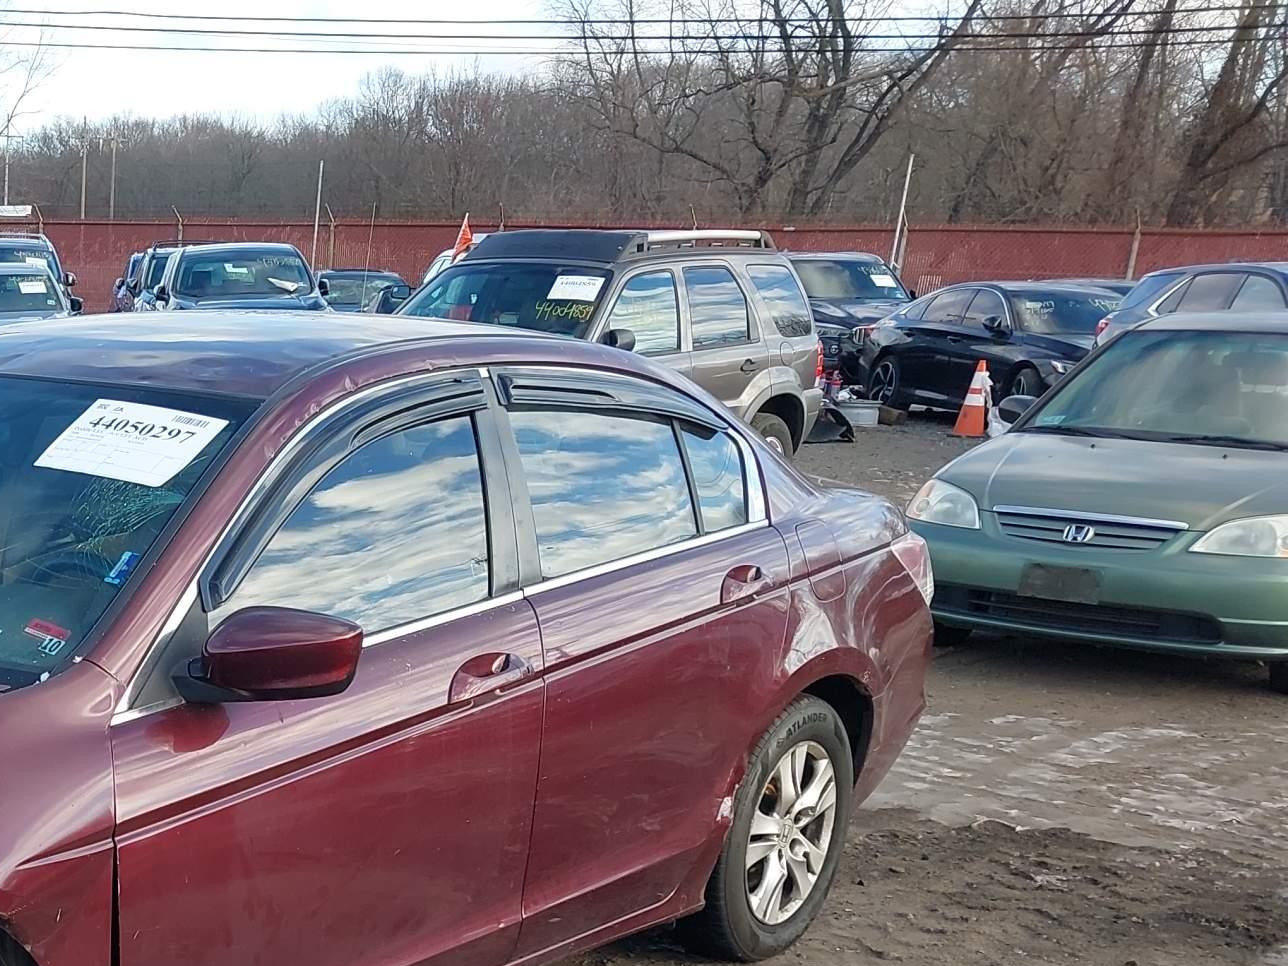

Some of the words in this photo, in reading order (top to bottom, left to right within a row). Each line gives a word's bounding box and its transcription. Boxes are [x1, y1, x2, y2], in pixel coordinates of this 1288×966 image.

[535, 301, 594, 320] 44004859
[88, 415, 196, 444] 44050297
[41, 638, 62, 653] 10
[785, 712, 828, 737] ATLANDER
